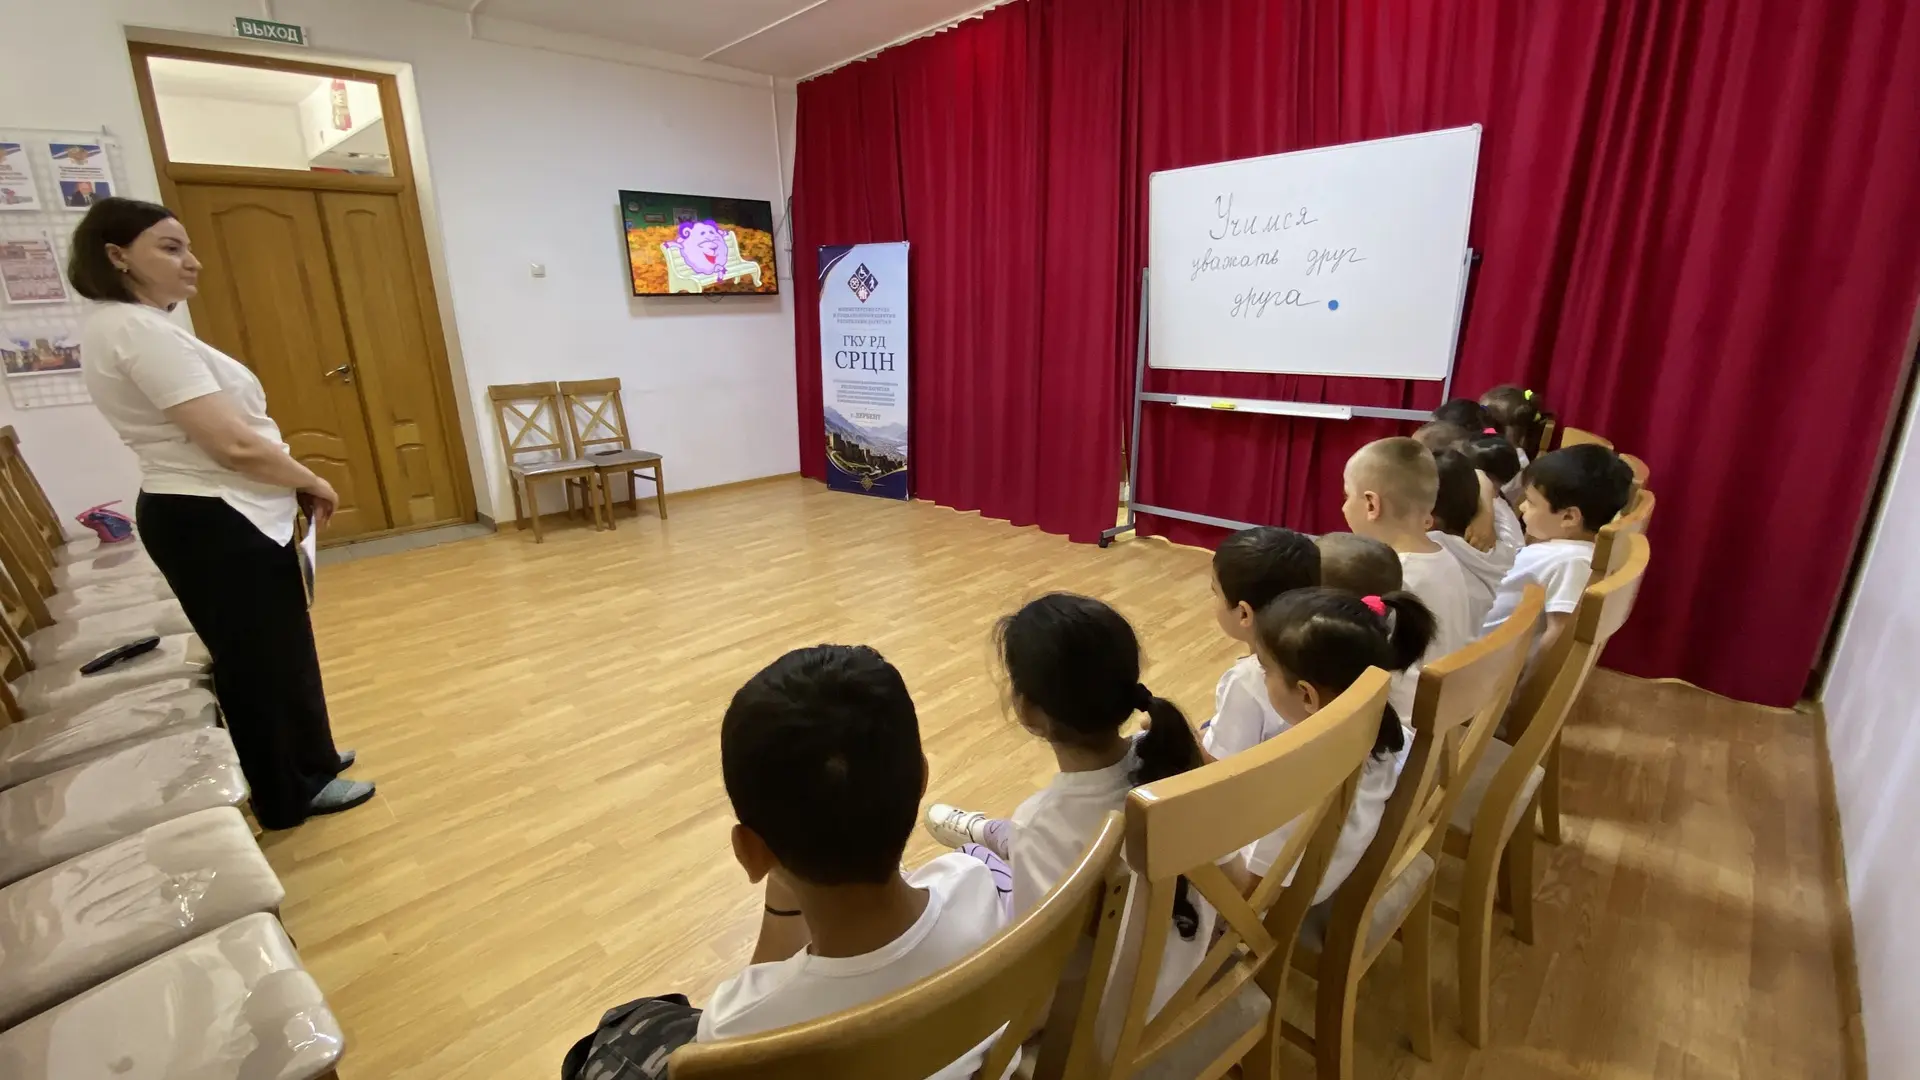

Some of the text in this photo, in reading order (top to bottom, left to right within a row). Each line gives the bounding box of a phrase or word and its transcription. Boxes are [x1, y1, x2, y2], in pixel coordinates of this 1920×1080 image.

[242, 21, 299, 43] ВЫХОД
[1209, 192, 1319, 240] Учимся
[1190, 247, 1368, 281] уважать друг
[1230, 287, 1321, 318] друга
[843, 335, 886, 350] ГКУ РД
[835, 350, 896, 376] СРЦН
